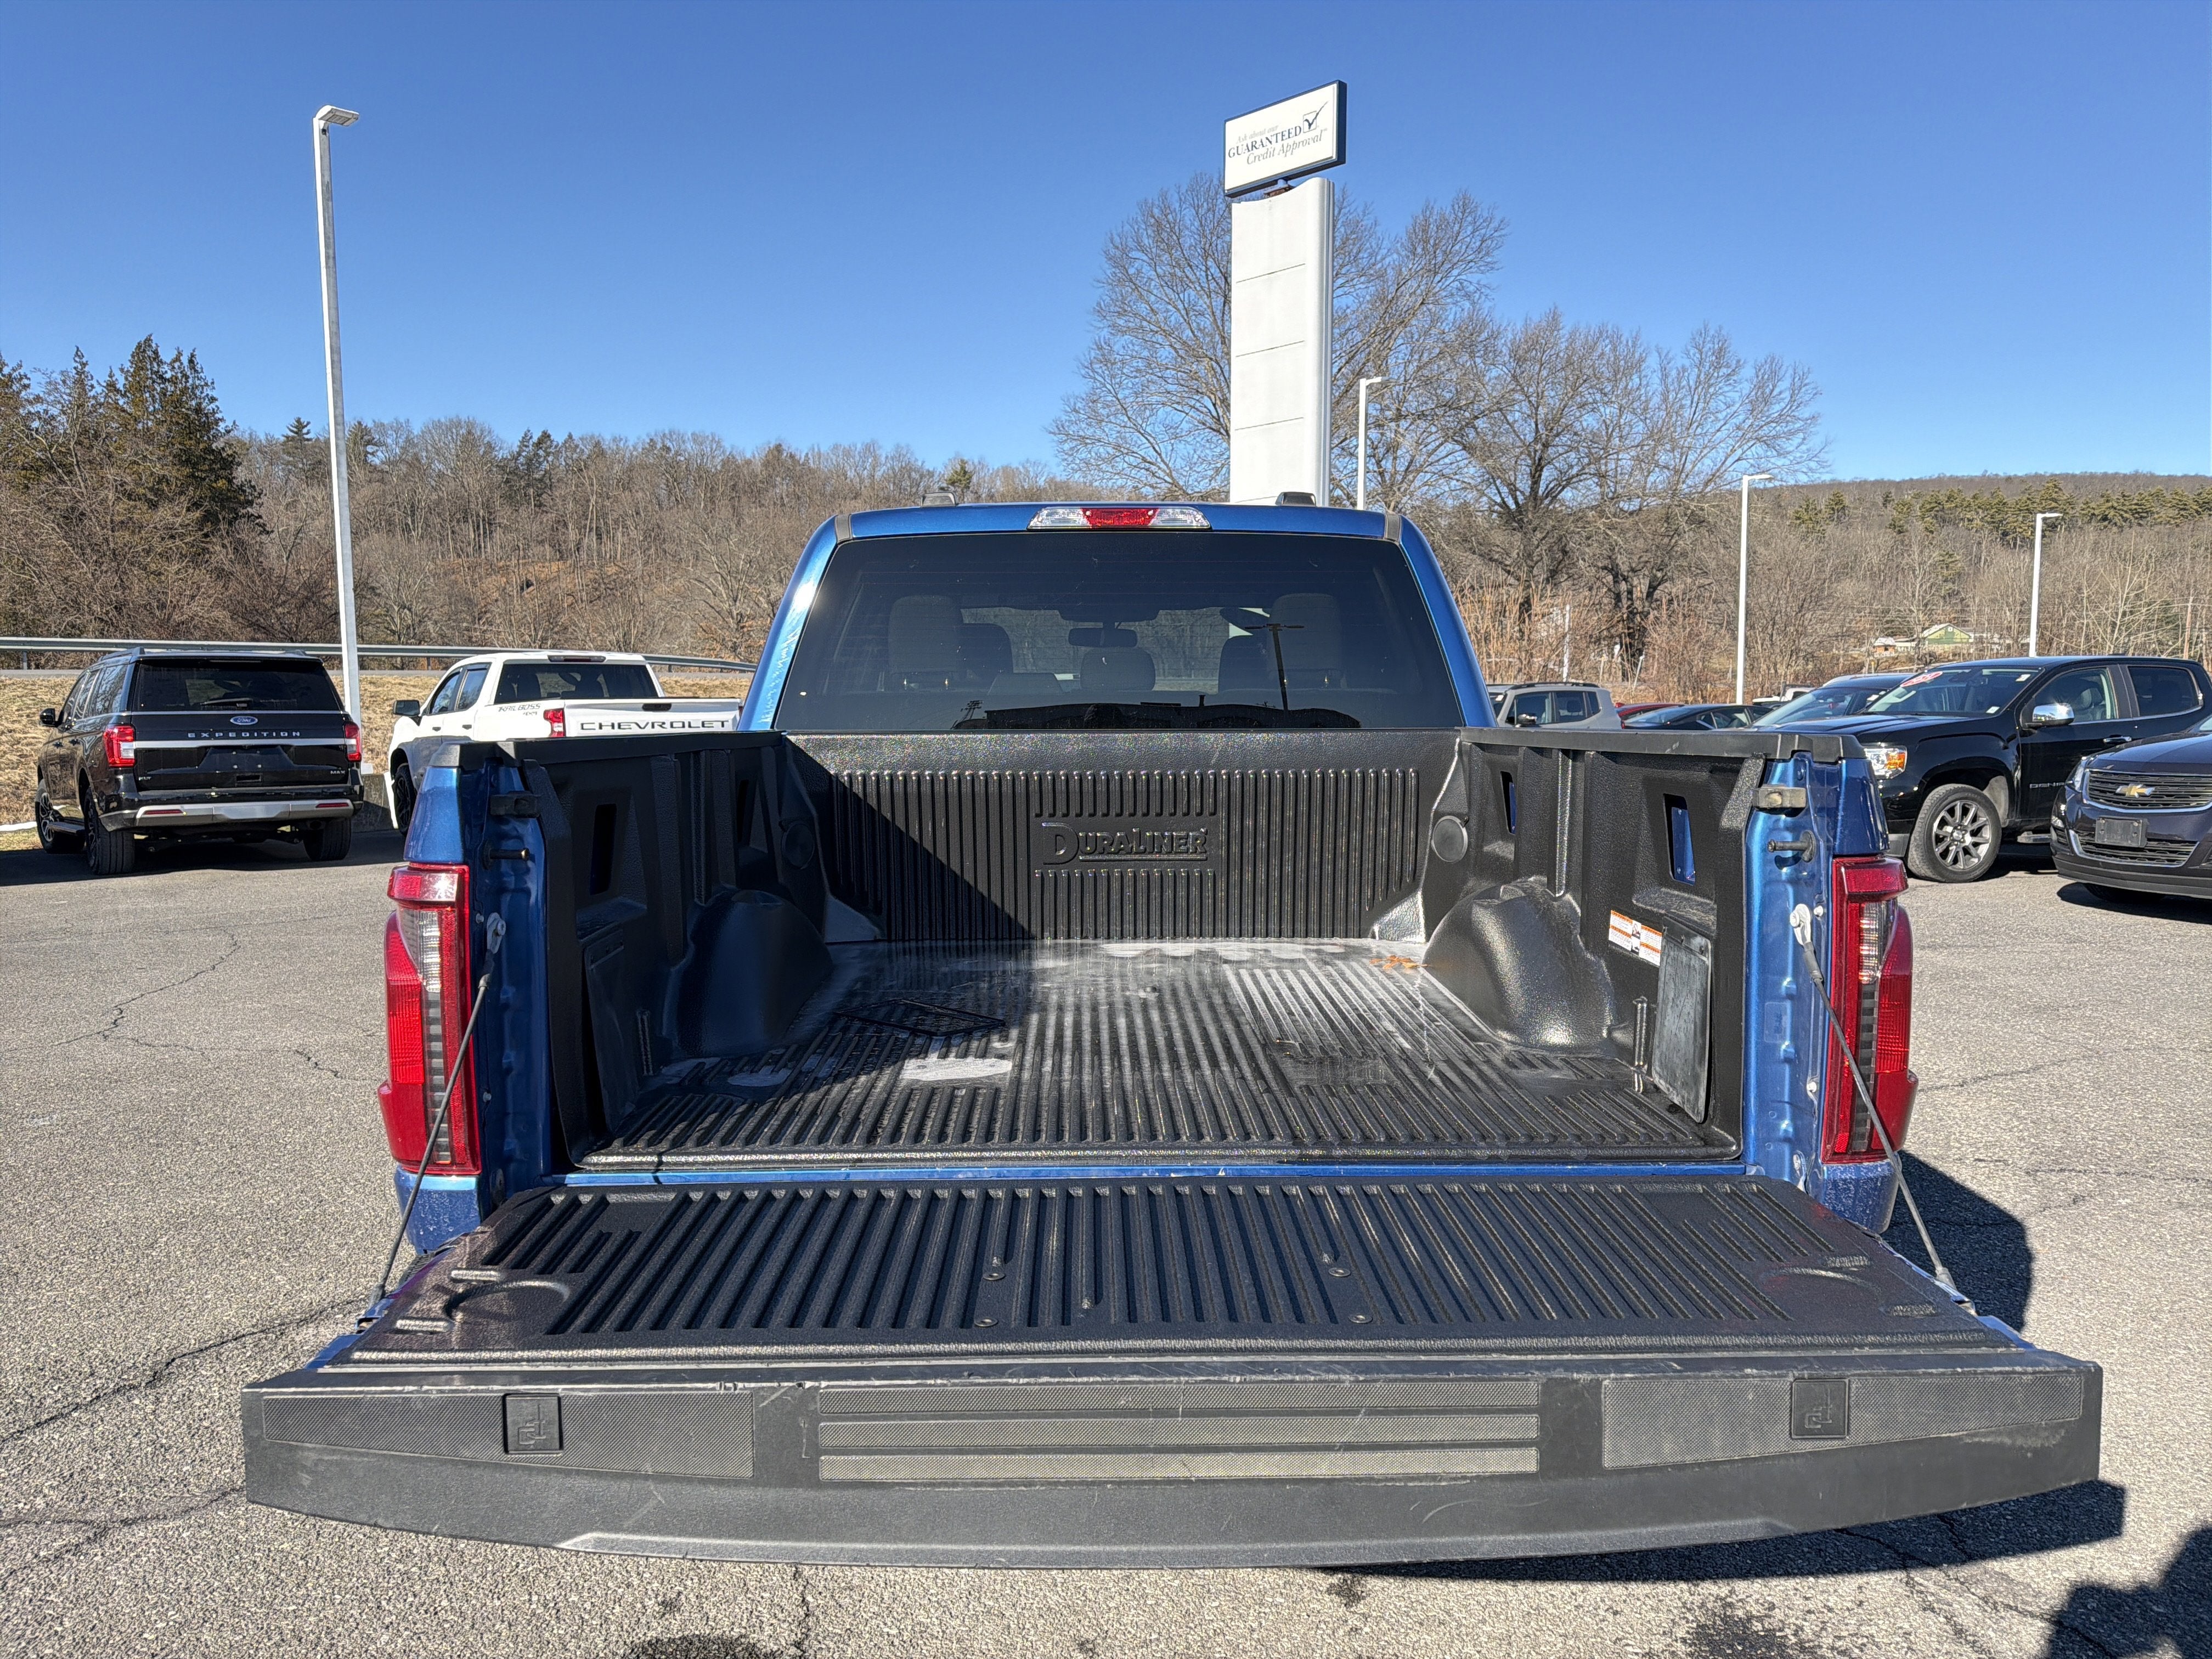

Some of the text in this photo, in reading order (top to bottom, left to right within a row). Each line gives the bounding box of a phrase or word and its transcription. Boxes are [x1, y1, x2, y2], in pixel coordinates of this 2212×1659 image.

[1228, 126, 1302, 158] GUARANTEED
[1237, 125, 1279, 143] Ask about our
[1246, 129, 1323, 165] Credit Approval
[580, 720, 729, 730] CHEVROLET
